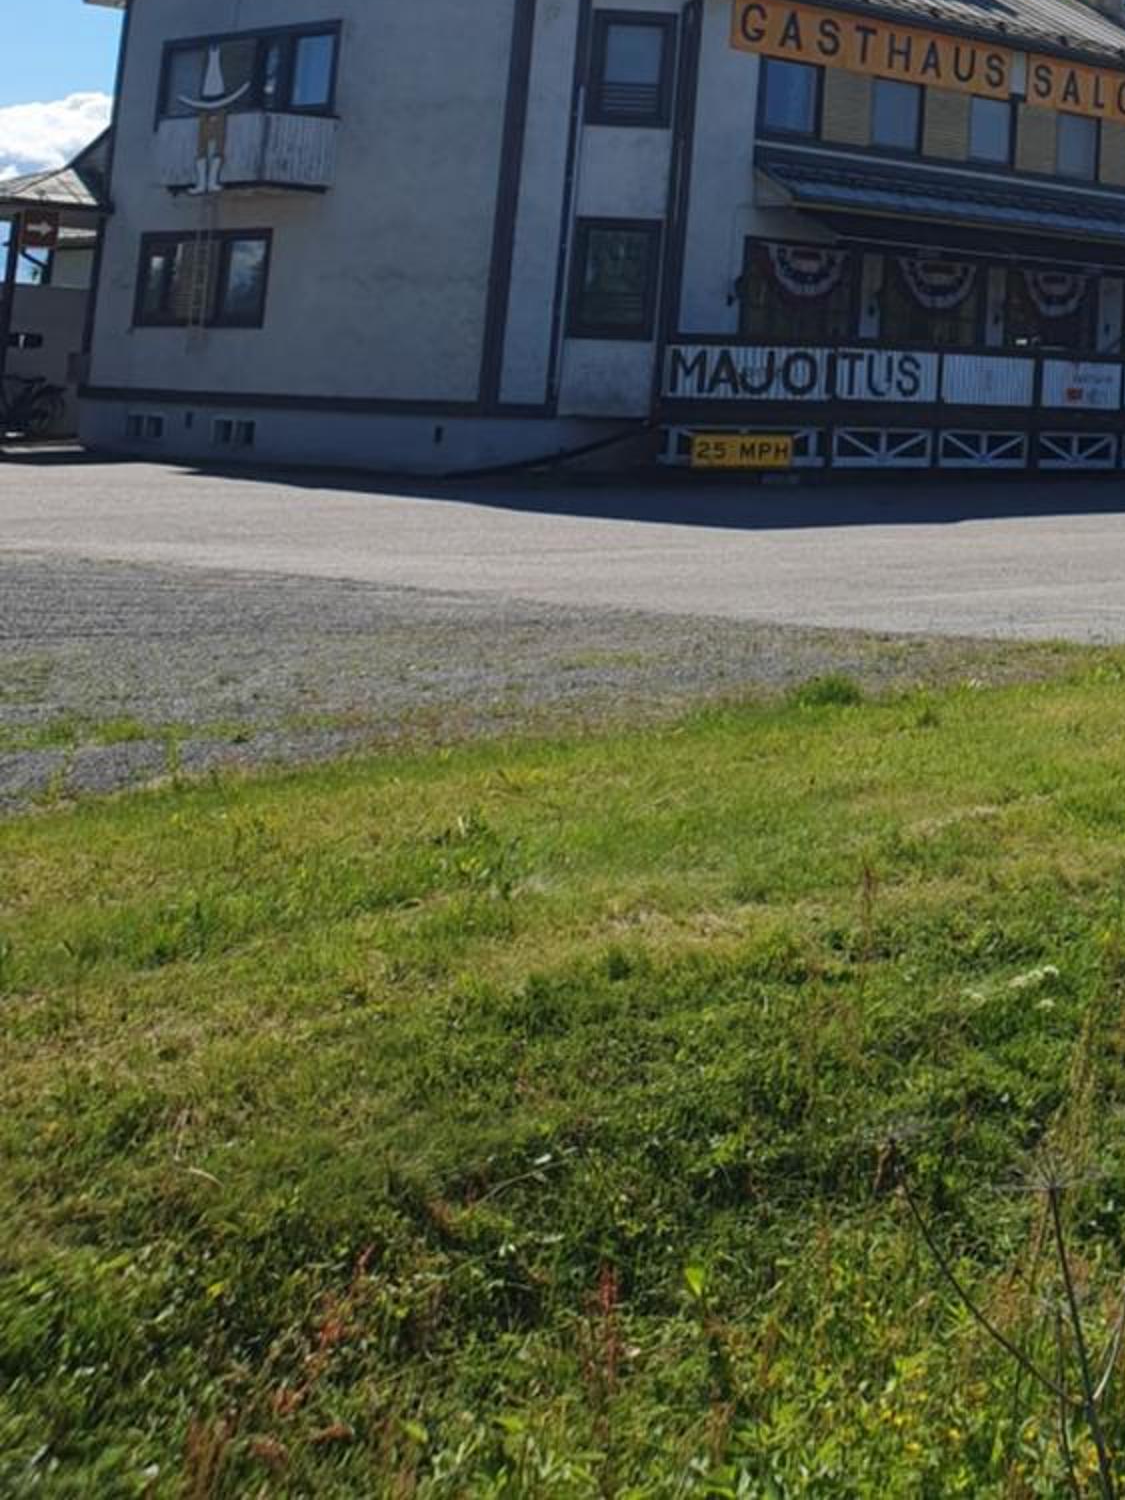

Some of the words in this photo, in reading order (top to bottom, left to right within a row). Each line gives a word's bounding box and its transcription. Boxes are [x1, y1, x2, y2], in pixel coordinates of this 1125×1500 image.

[740, 3, 1006, 88] GASTHAUS
[669, 349, 921, 397] MAJOITUS
[696, 441, 727, 460] 25
[740, 442, 789, 461] MPH
